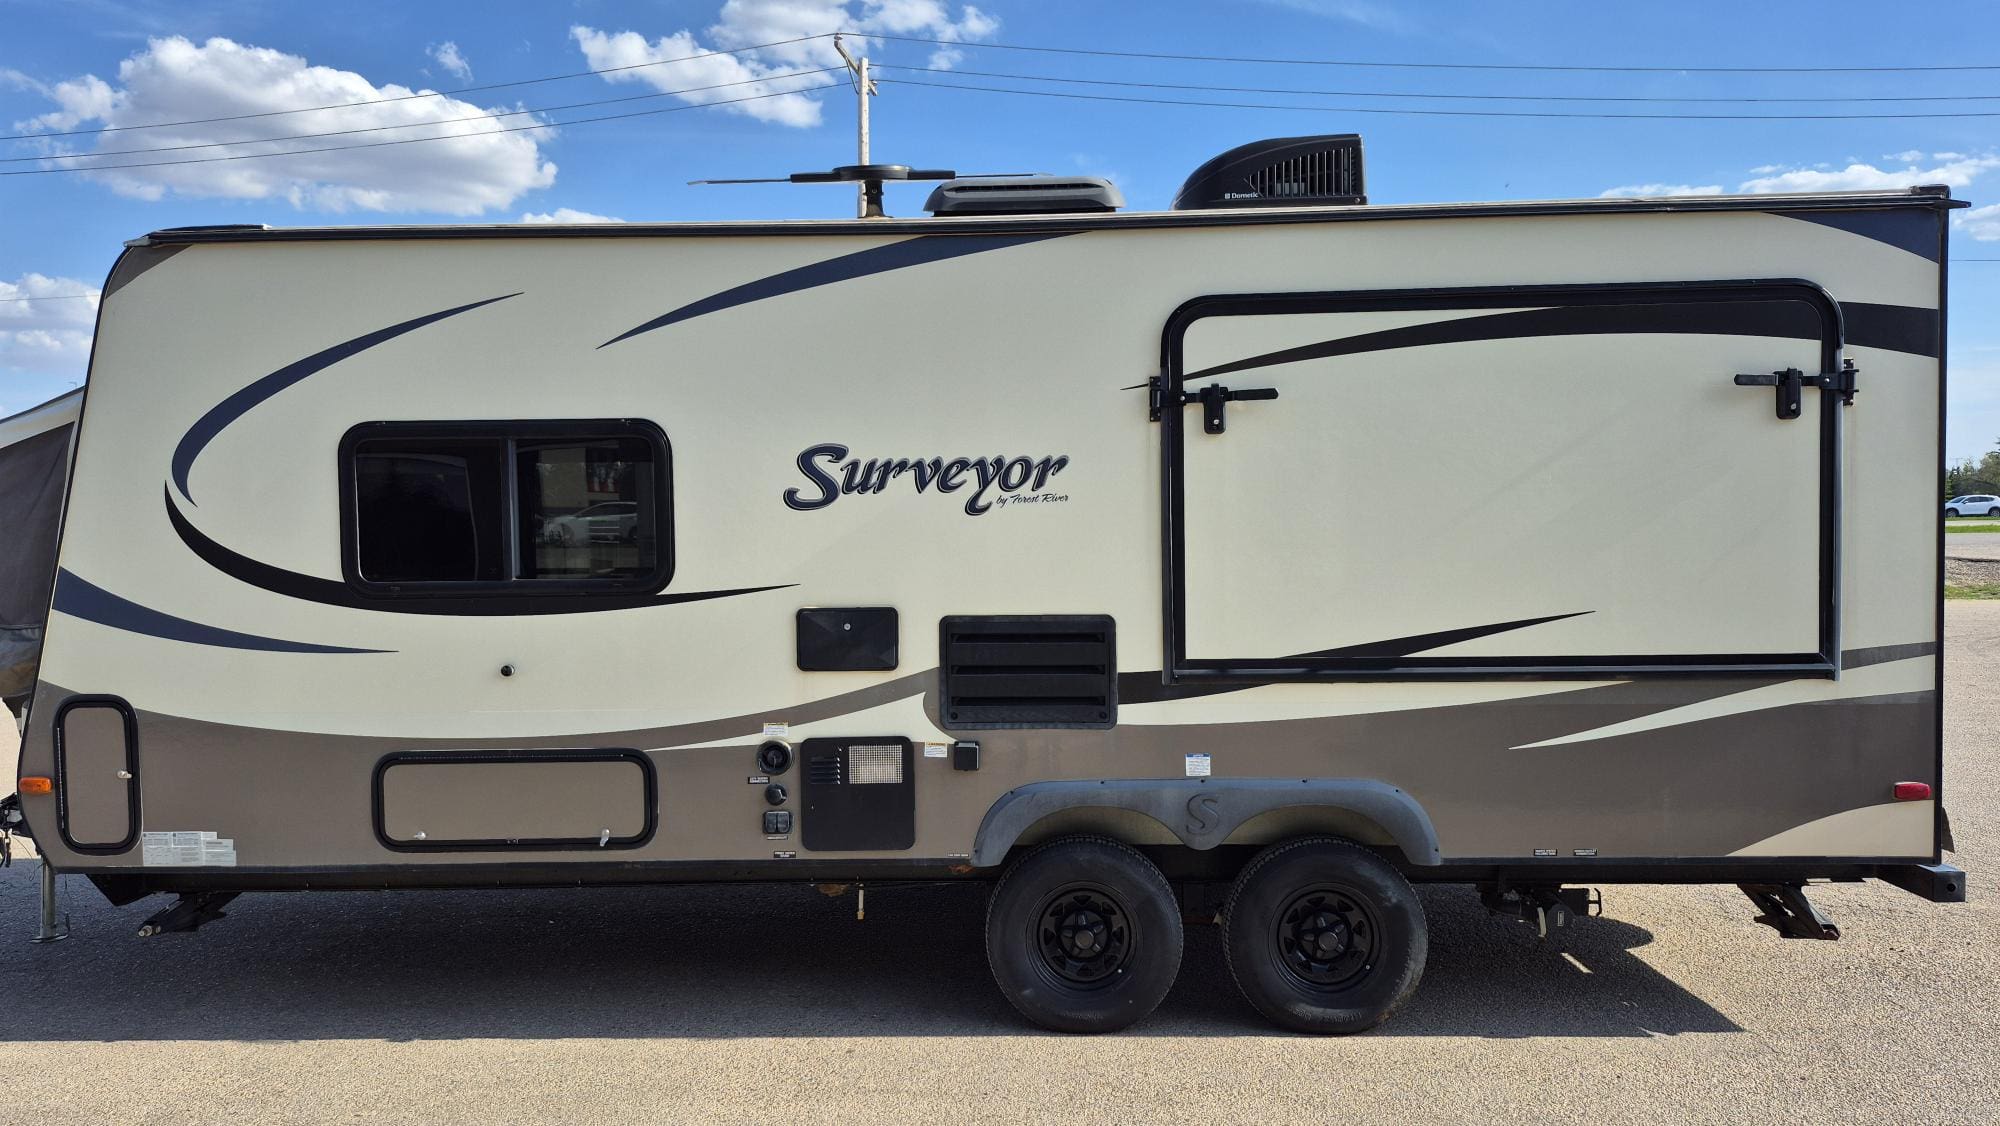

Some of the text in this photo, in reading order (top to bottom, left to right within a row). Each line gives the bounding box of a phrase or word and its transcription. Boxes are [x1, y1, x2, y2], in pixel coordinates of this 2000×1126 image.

[783, 443, 1069, 516] Surveyor
[996, 493, 1068, 508] by Forest River
[1186, 793, 1222, 835] S
